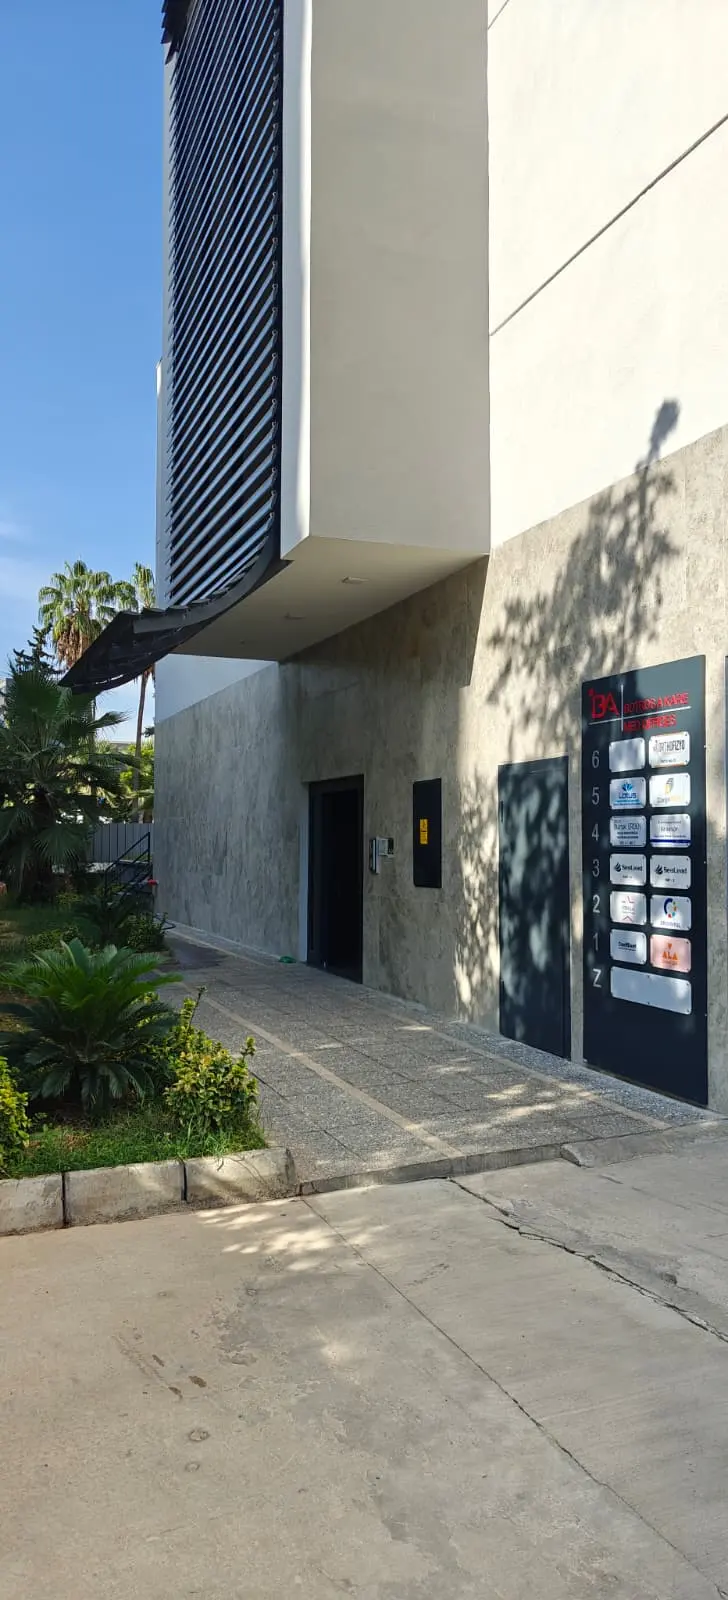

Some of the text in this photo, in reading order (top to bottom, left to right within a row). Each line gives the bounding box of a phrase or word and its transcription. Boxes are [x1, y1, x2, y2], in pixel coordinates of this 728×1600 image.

[592, 750, 600, 768] 6
[592, 787, 600, 805] 5
[592, 823, 600, 841] 4
[592, 859, 600, 877] 3
[592, 894, 601, 914] 2
[592, 932, 599, 951] 1
[662, 951, 678, 961] ALA
[592, 969, 602, 988] Z
